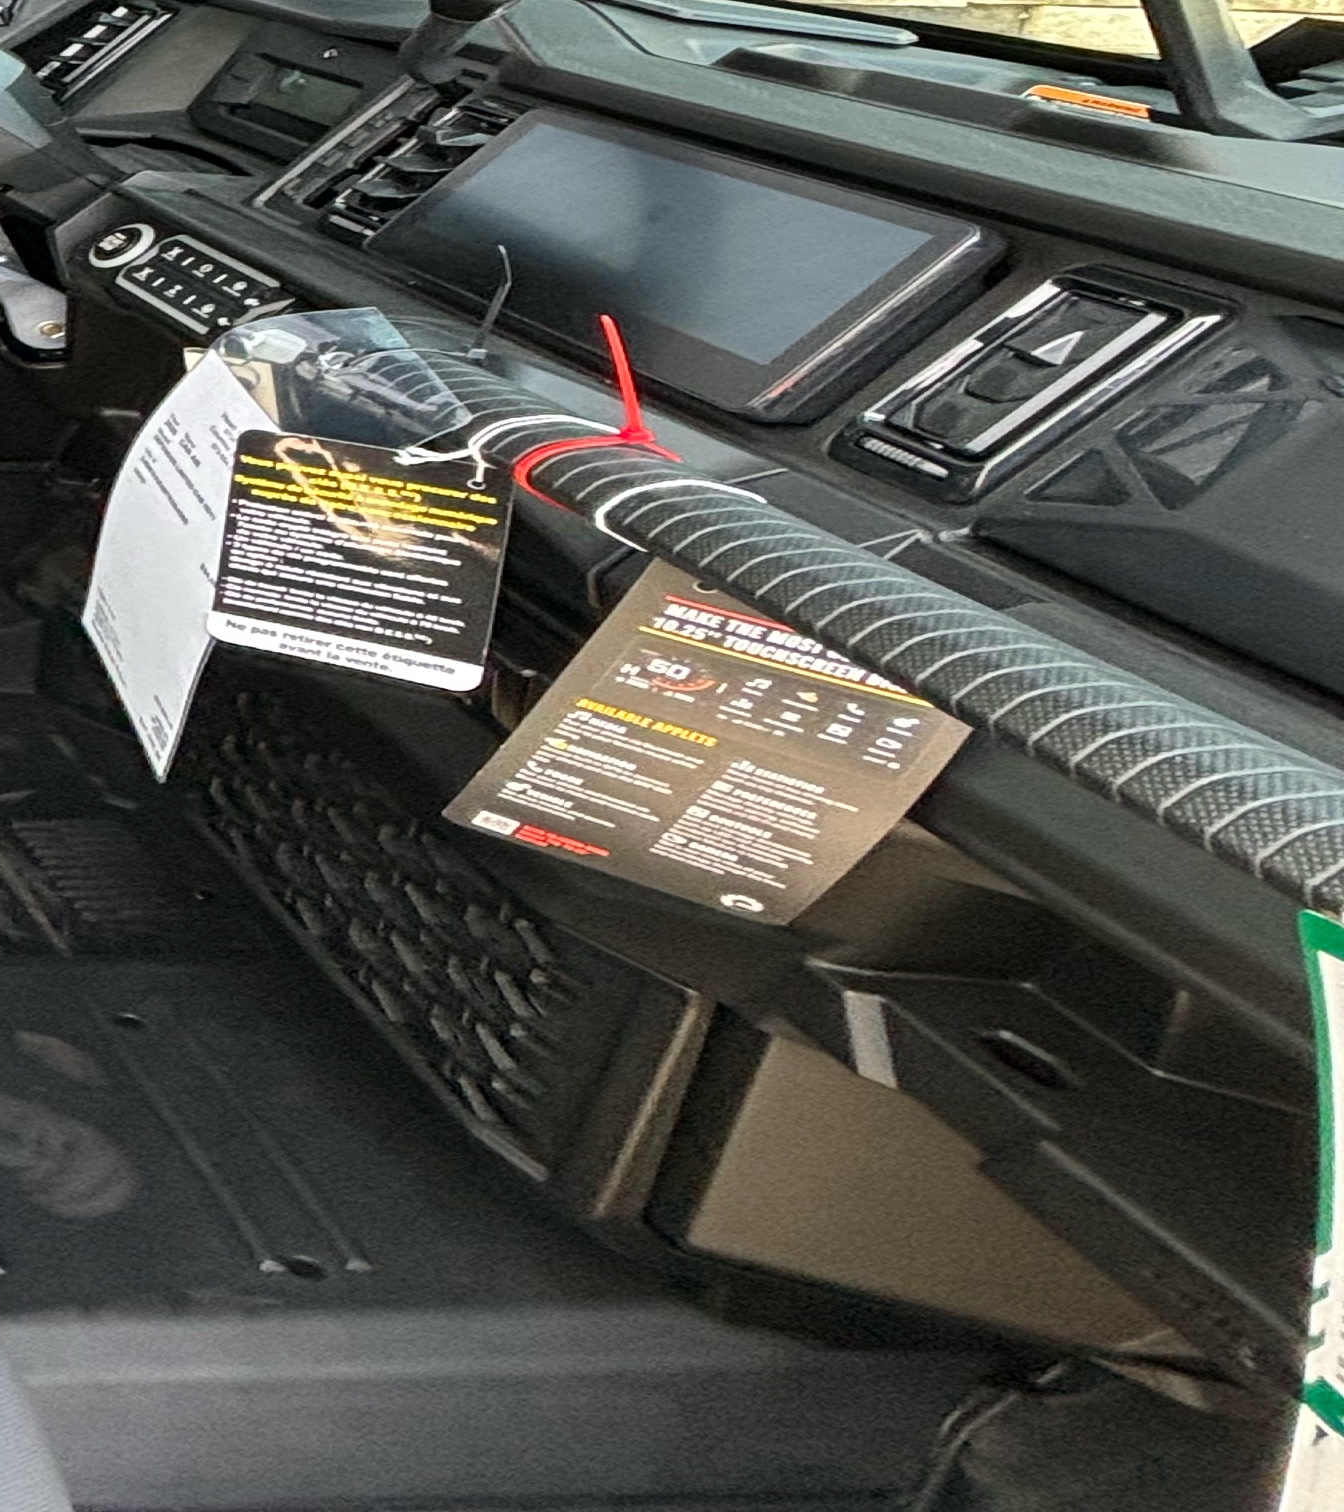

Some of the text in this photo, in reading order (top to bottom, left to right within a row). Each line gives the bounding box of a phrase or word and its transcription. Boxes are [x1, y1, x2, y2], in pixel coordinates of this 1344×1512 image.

[664, 604, 724, 629] MAKE
[726, 618, 768, 639] THE
[225, 619, 456, 675] Ne pas retirer cette étiquette
[278, 641, 322, 659] avant
[326, 651, 341, 662] la
[723, 635, 866, 683] TOUCHSCREEN
[575, 698, 653, 729] AVAILABLE
[651, 722, 718, 747] APPLETS
